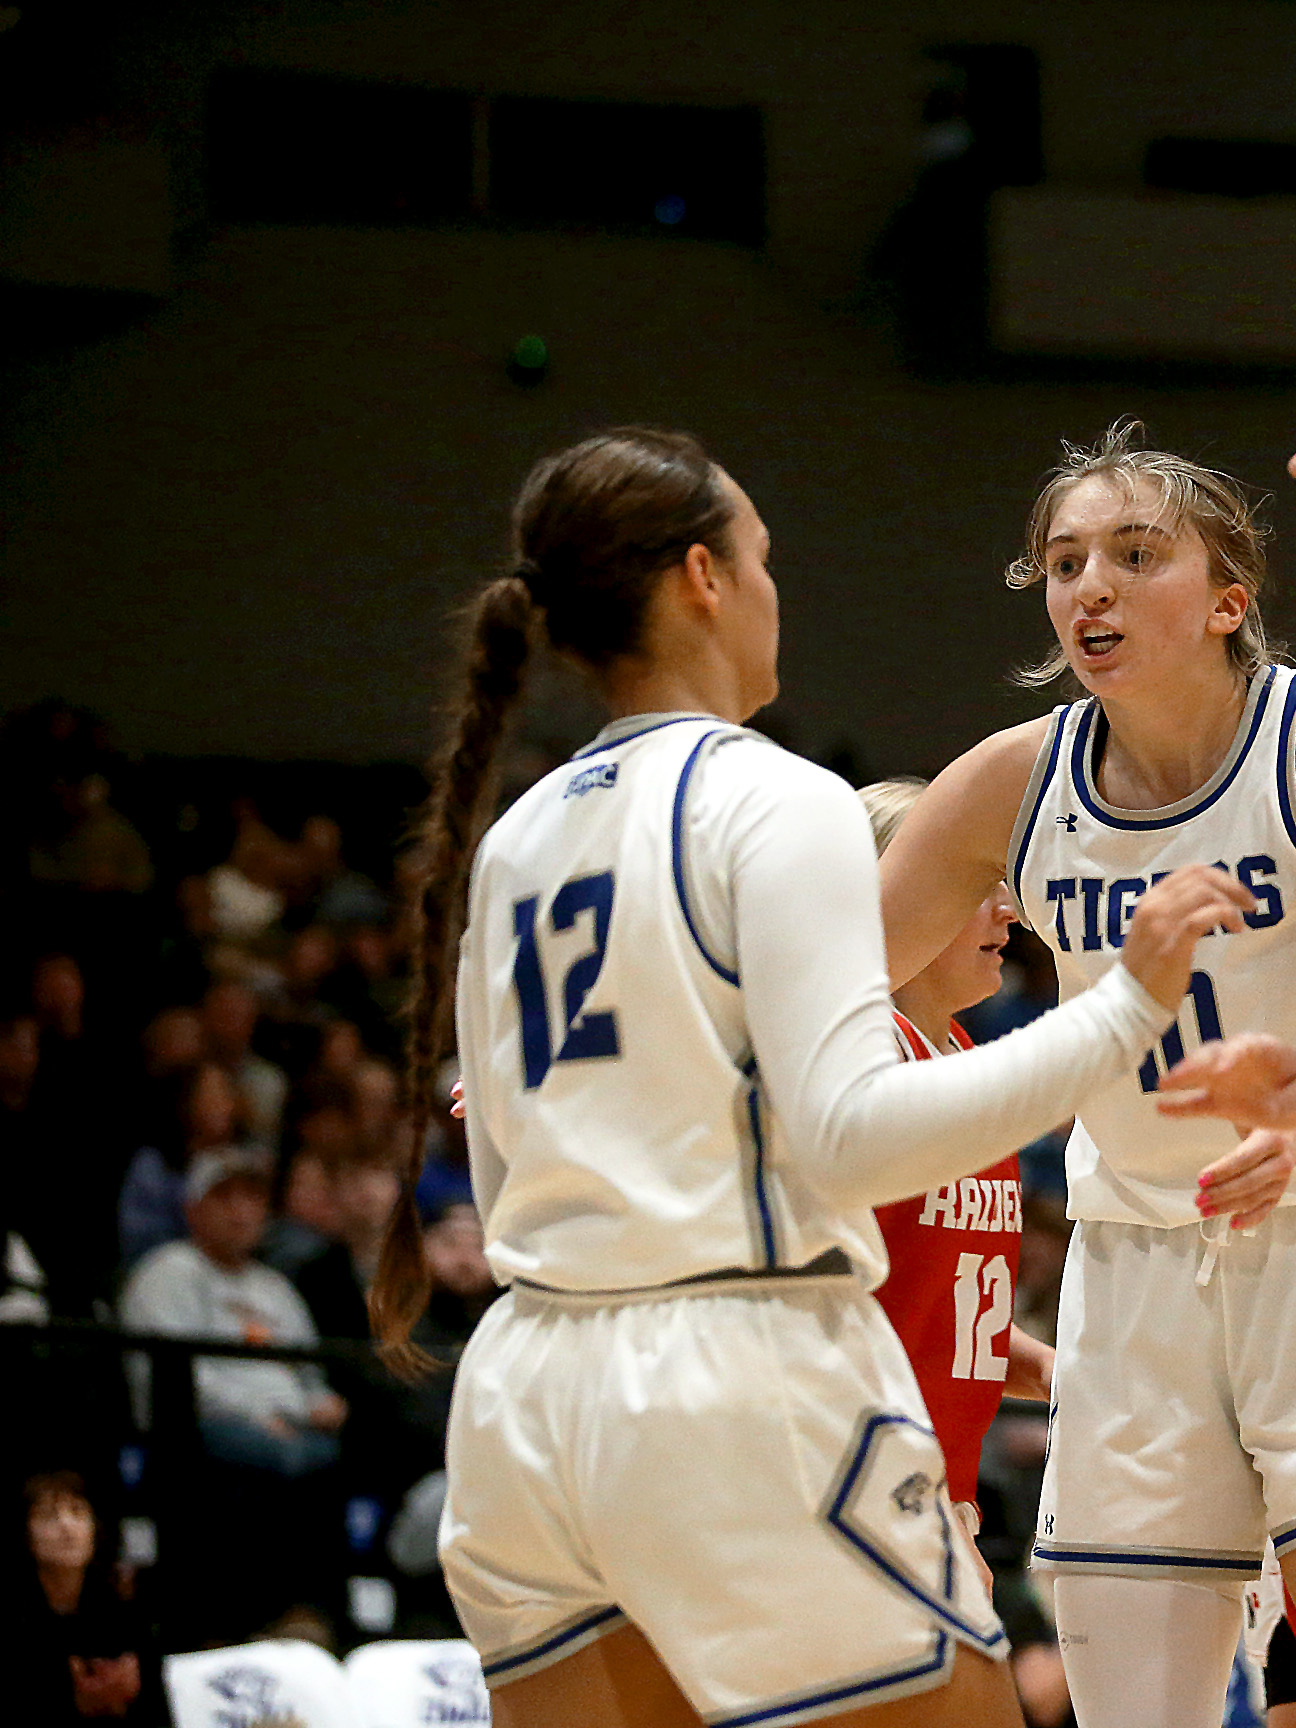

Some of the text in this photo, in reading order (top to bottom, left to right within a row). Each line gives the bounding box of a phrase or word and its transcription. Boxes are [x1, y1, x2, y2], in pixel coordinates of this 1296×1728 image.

[1046, 854, 1285, 953] TIGS
[513, 869, 623, 1092] 12
[918, 1177, 1023, 1233] RAIDE
[951, 1252, 1012, 1382] 12
